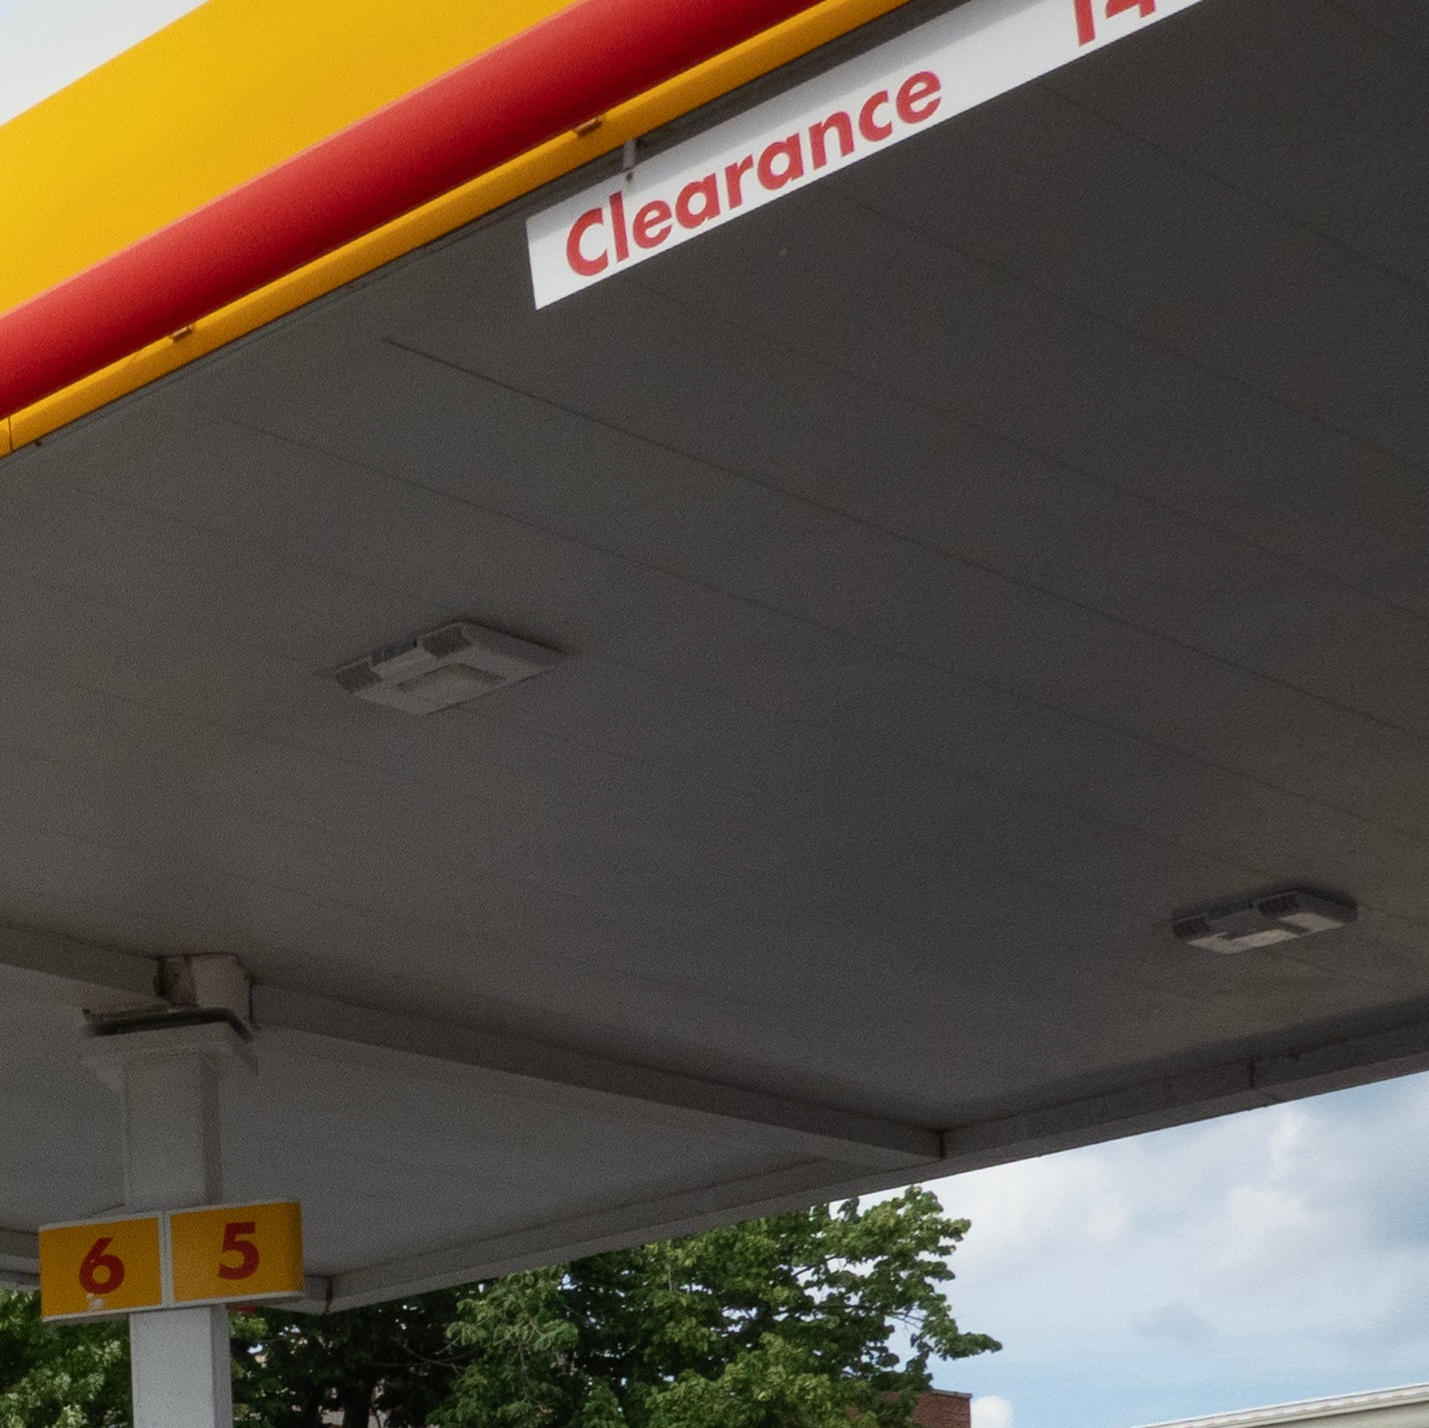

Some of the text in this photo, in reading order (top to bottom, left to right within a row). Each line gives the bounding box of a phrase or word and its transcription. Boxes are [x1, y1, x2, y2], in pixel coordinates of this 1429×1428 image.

[564, 69, 944, 279] Clearance
[78, 1236, 127, 1295] 6
[217, 1221, 261, 1281] 5
